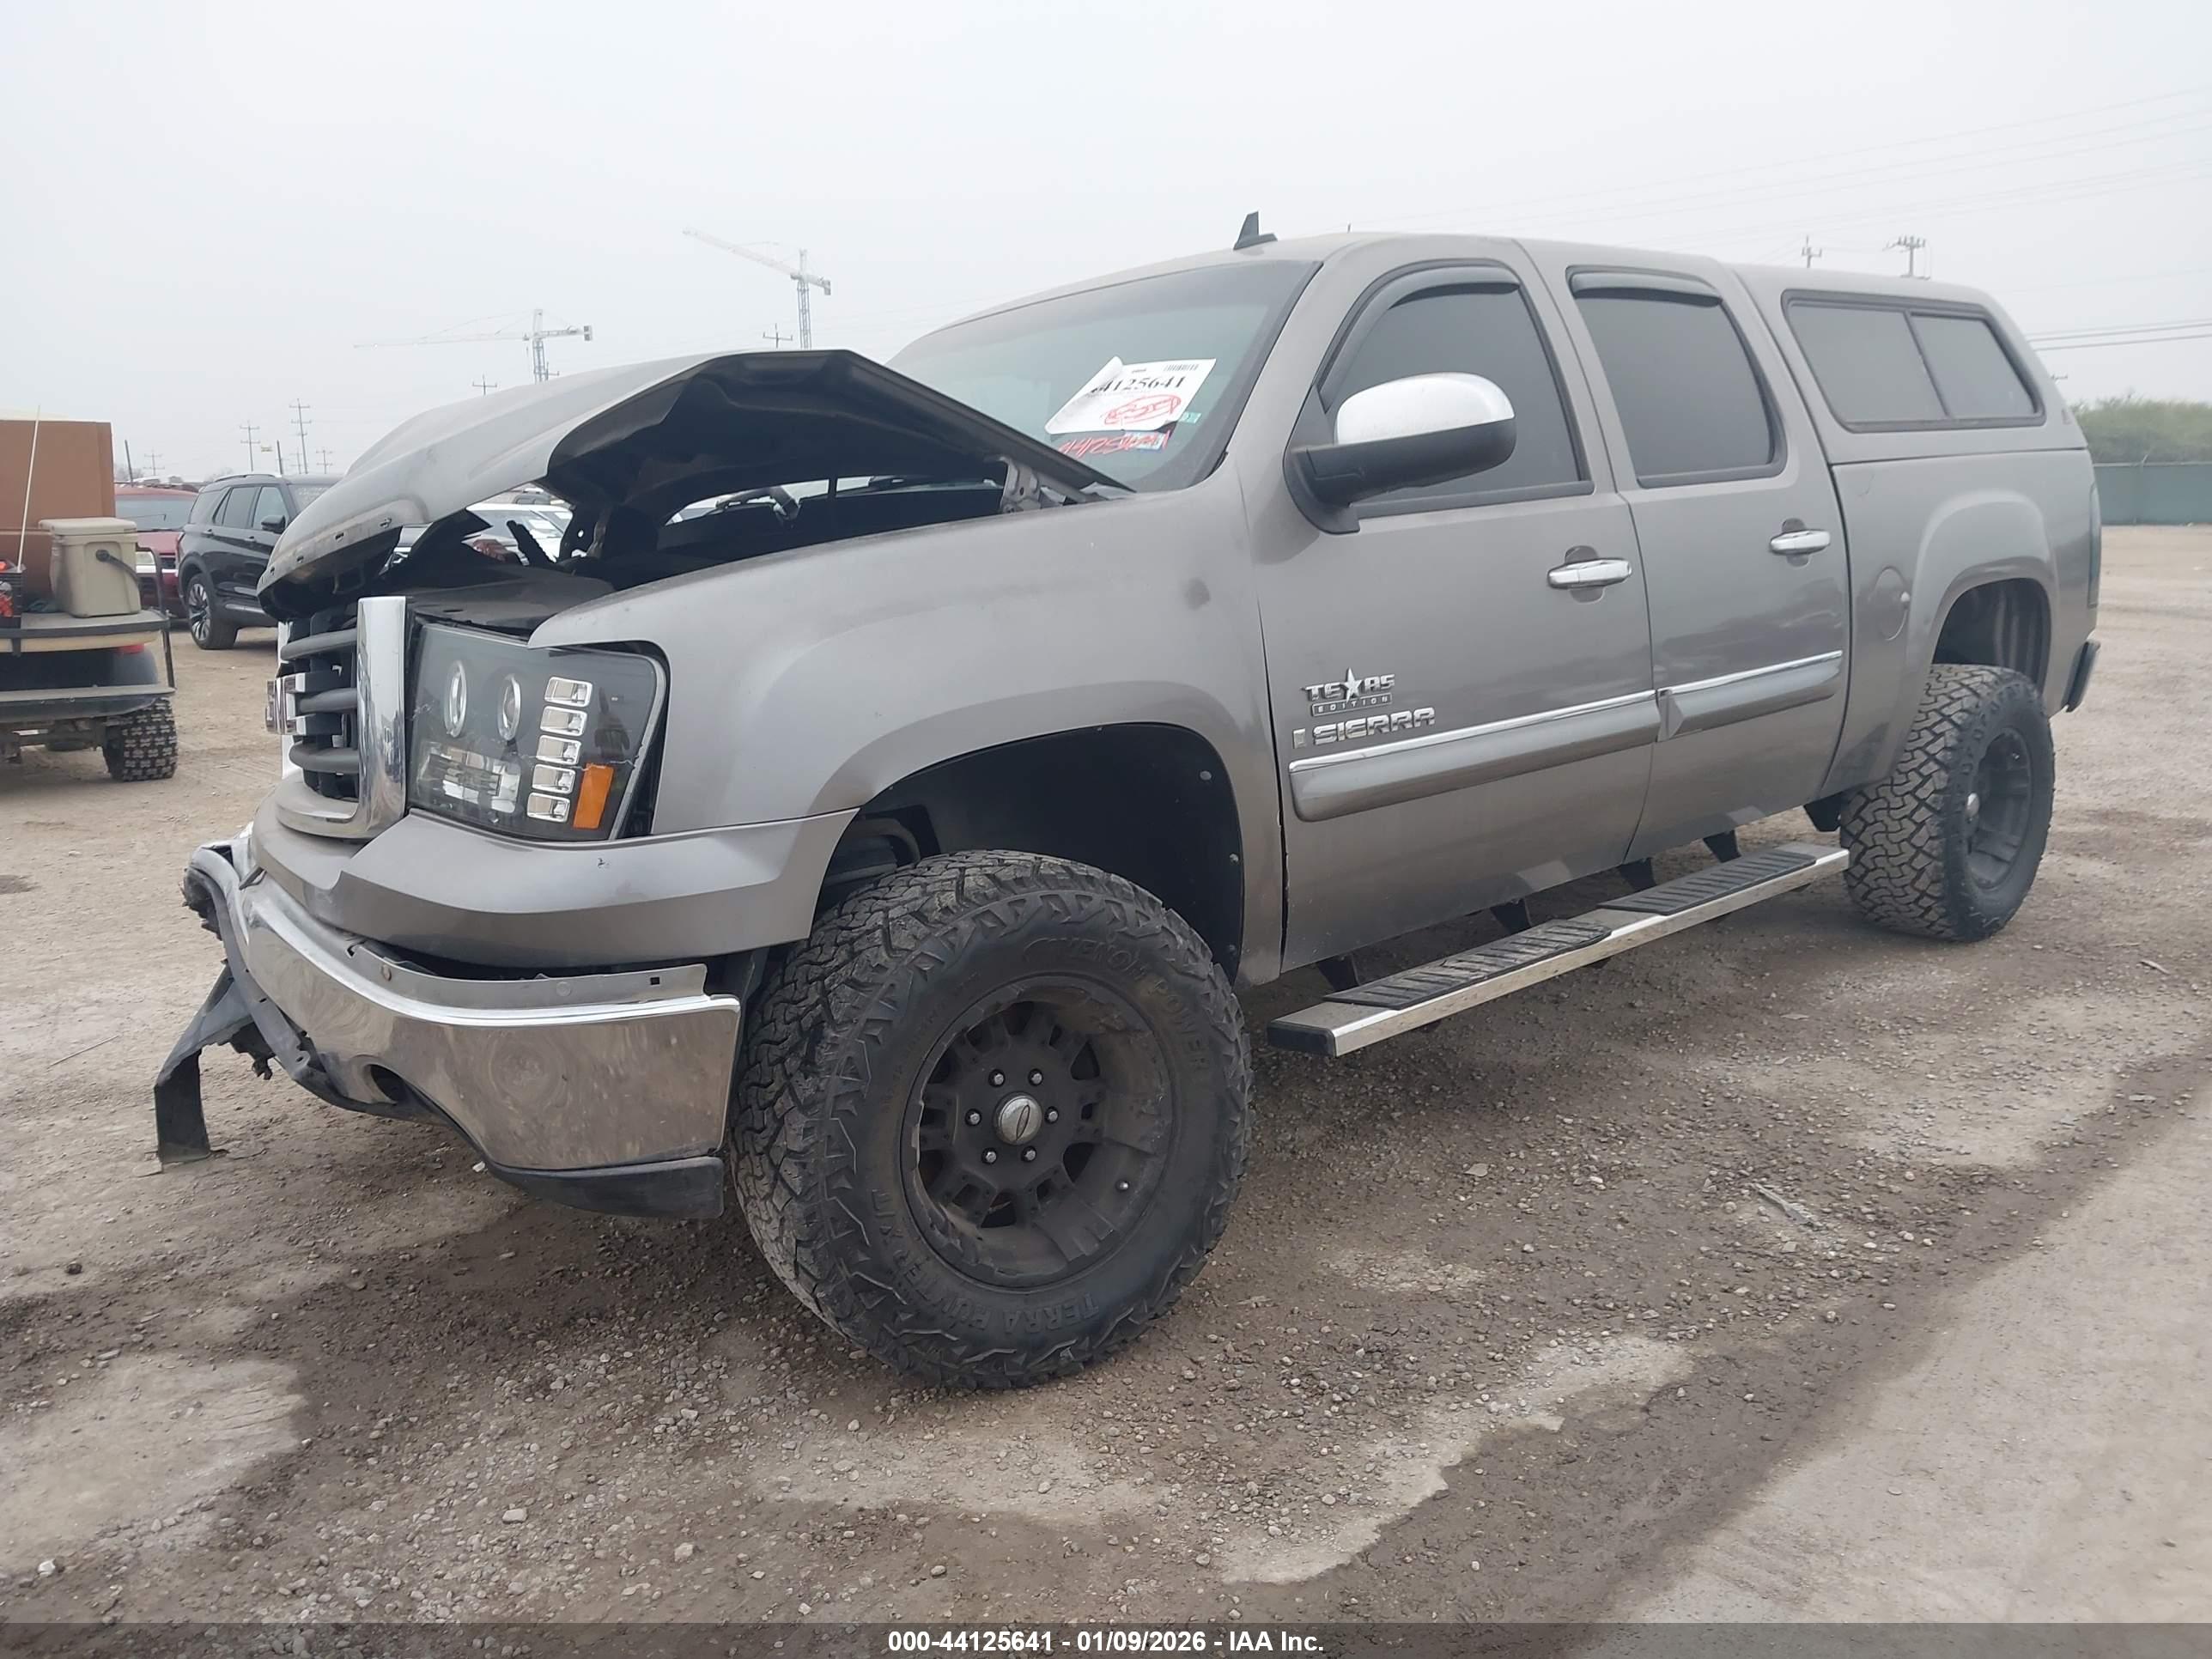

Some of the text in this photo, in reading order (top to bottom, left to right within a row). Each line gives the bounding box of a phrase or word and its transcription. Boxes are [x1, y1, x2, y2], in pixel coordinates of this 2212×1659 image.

[1317, 696, 1389, 714] EDITION
[1312, 706, 1436, 746] SIERRA
[1146, 978, 1212, 1072] POWER
[1003, 1291, 1101, 1334] TERRA
